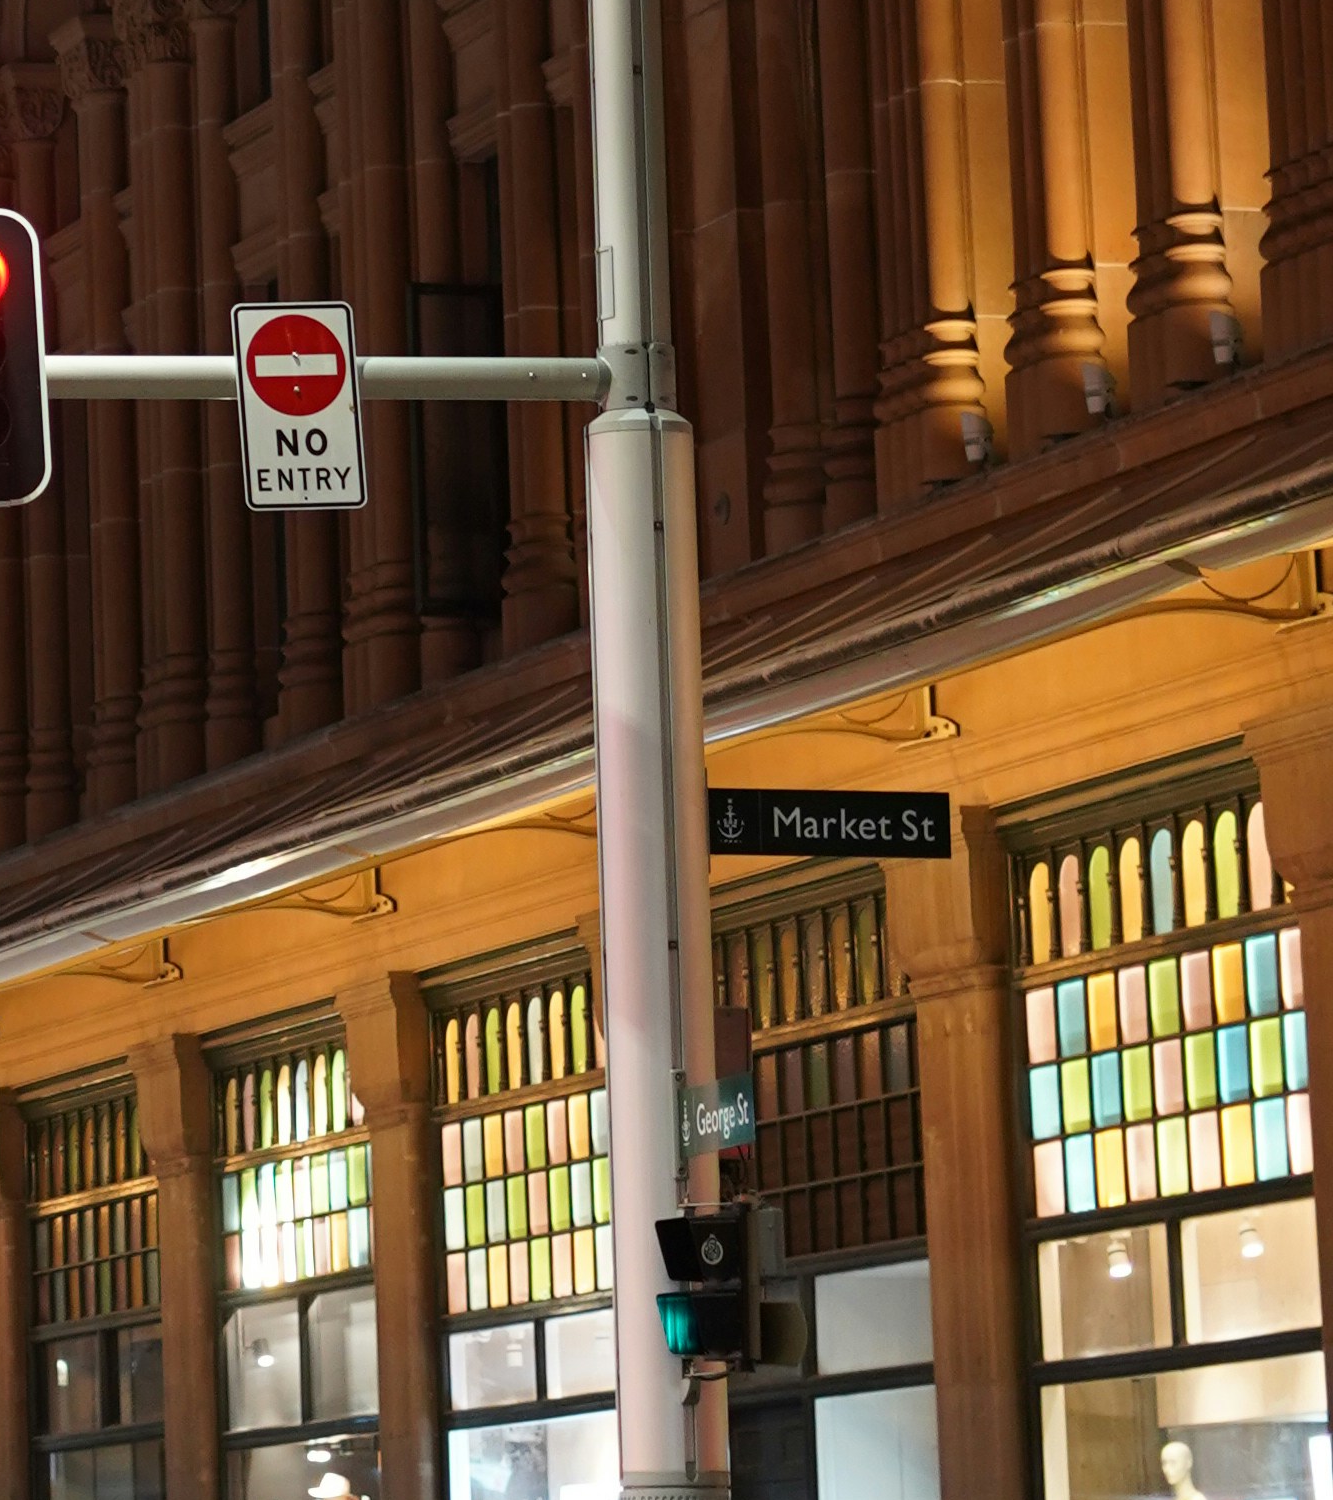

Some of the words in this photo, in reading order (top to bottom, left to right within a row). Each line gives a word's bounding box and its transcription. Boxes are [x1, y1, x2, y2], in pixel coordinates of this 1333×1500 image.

[276, 428, 328, 456] NO
[257, 467, 351, 491] ENTRY
[772, 806, 893, 841] Market
[901, 809, 936, 842] St
[696, 1103, 735, 1140] George
[737, 1092, 749, 1126] St
